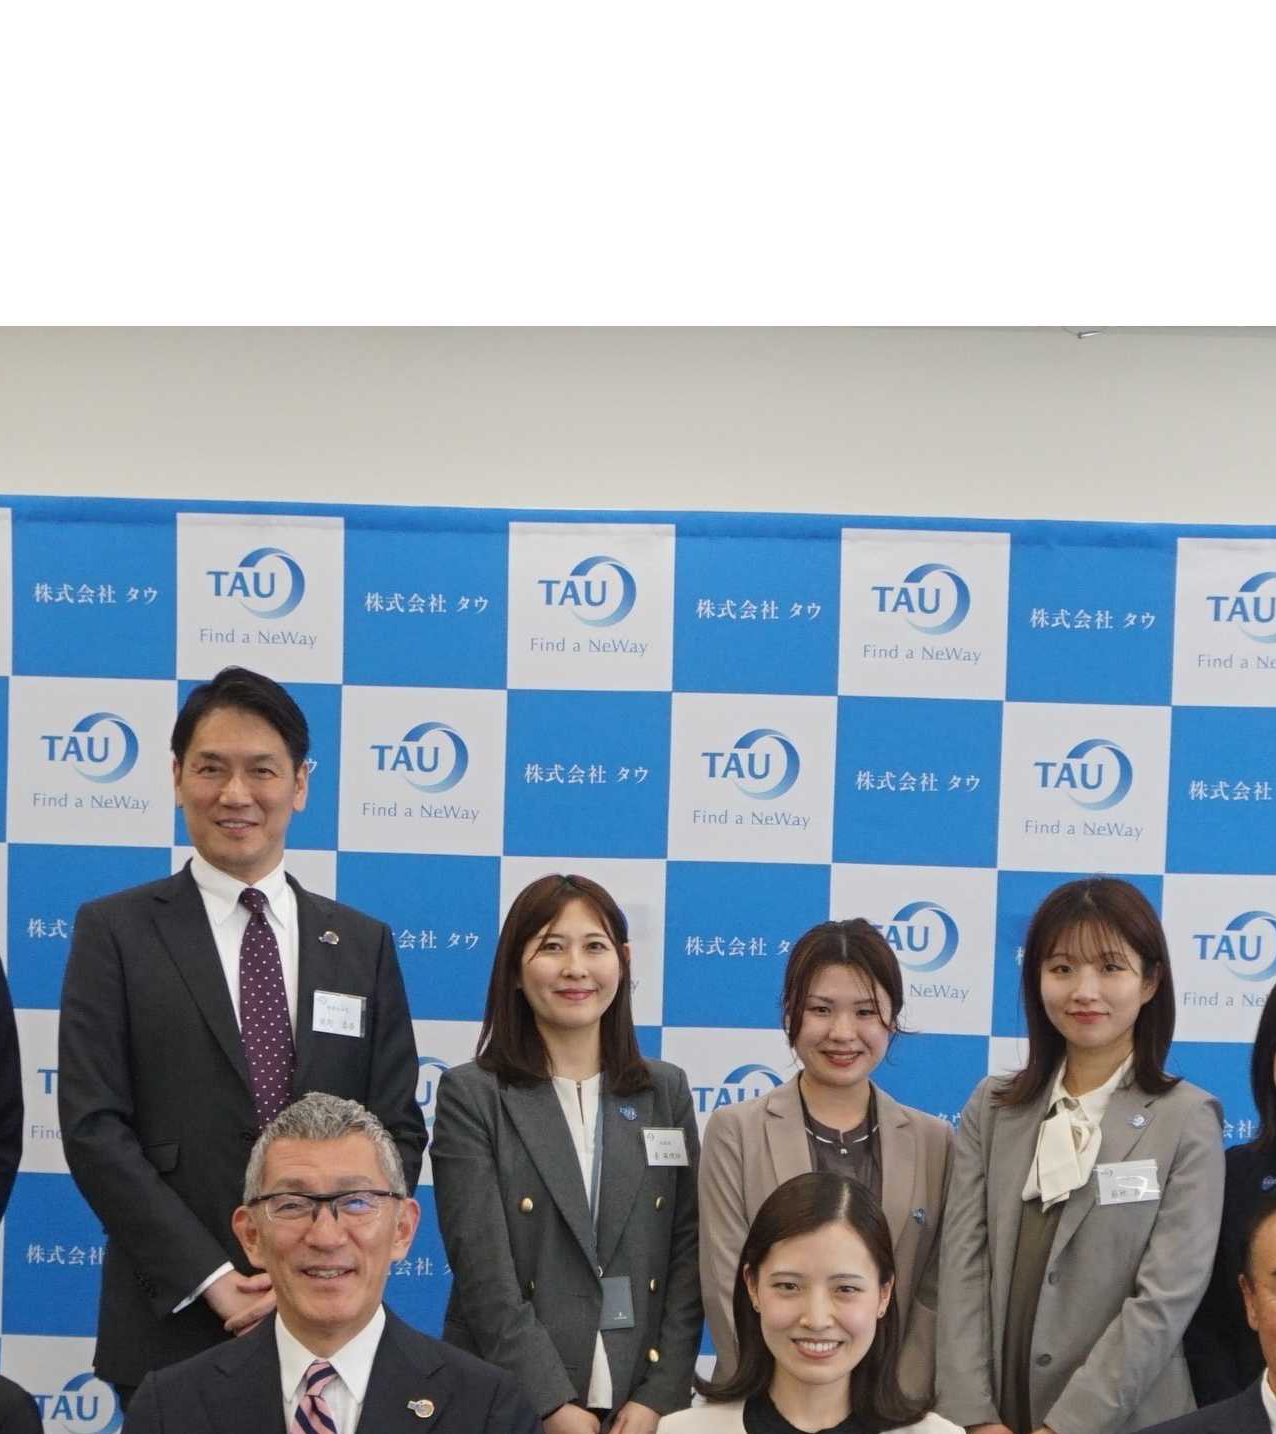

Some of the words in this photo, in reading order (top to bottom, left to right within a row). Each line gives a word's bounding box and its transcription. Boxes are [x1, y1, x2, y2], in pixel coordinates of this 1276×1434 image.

[34, 583, 115, 603] 株式会社
[127, 587, 157, 602] タウ
[207, 571, 275, 598] TAU
[538, 580, 606, 606] TAU
[365, 592, 446, 613] 株式会社
[458, 596, 488, 612] タウ
[696, 599, 778, 619] 株式会社
[791, 603, 821, 619] タウ
[872, 587, 940, 614] TAU
[1206, 596, 1275, 623] TAU
[1030, 608, 1112, 629] 株式会社
[1125, 612, 1155, 628] タウ
[198, 629, 234, 643] Find
[242, 633, 250, 643] a
[258, 631, 317, 648] NeWay
[529, 638, 565, 651] Find
[573, 642, 580, 652] a
[589, 640, 647, 656] NeWay
[862, 644, 898, 658] Find
[906, 649, 914, 659] a
[922, 646, 981, 664] NeWay
[1196, 654, 1233, 668] Find
[1240, 658, 1248, 669] a
[41, 736, 109, 763] TAU
[371, 745, 439, 772] TAU
[525, 764, 605, 784] 株式会社
[618, 767, 648, 783] タウ
[701, 752, 770, 779] TAU
[856, 771, 937, 791] 株式会社
[949, 775, 980, 791] タウ
[1034, 762, 1103, 790] TAU
[1189, 781, 1271, 800] 株式会社
[31, 793, 68, 807] Find
[75, 798, 83, 808] a
[91, 795, 149, 813] NeWay
[361, 802, 397, 816] Find
[405, 808, 411, 817] a
[421, 804, 478, 823] NeWay
[691, 809, 727, 824] Find
[735, 815, 743, 824] a
[752, 812, 810, 830] NeWay
[1023, 820, 1060, 834] Find
[1067, 825, 1075, 835] a
[1083, 822, 1142, 840] NeWay
[28, 919, 67, 938] 株式
[871, 924, 929, 952] AU
[398, 930, 437, 950] 会社
[449, 933, 478, 949] タウ
[686, 936, 766, 956] 株式会社
[776, 940, 790, 955] タ
[1193, 935, 1261, 961] TAU
[910, 984, 969, 1002] NeWay
[1181, 992, 1218, 1006] Find
[1226, 996, 1234, 1006] a
[27, 1243, 105, 1265] 株式会社
[34, 1395, 98, 1421] TAU
